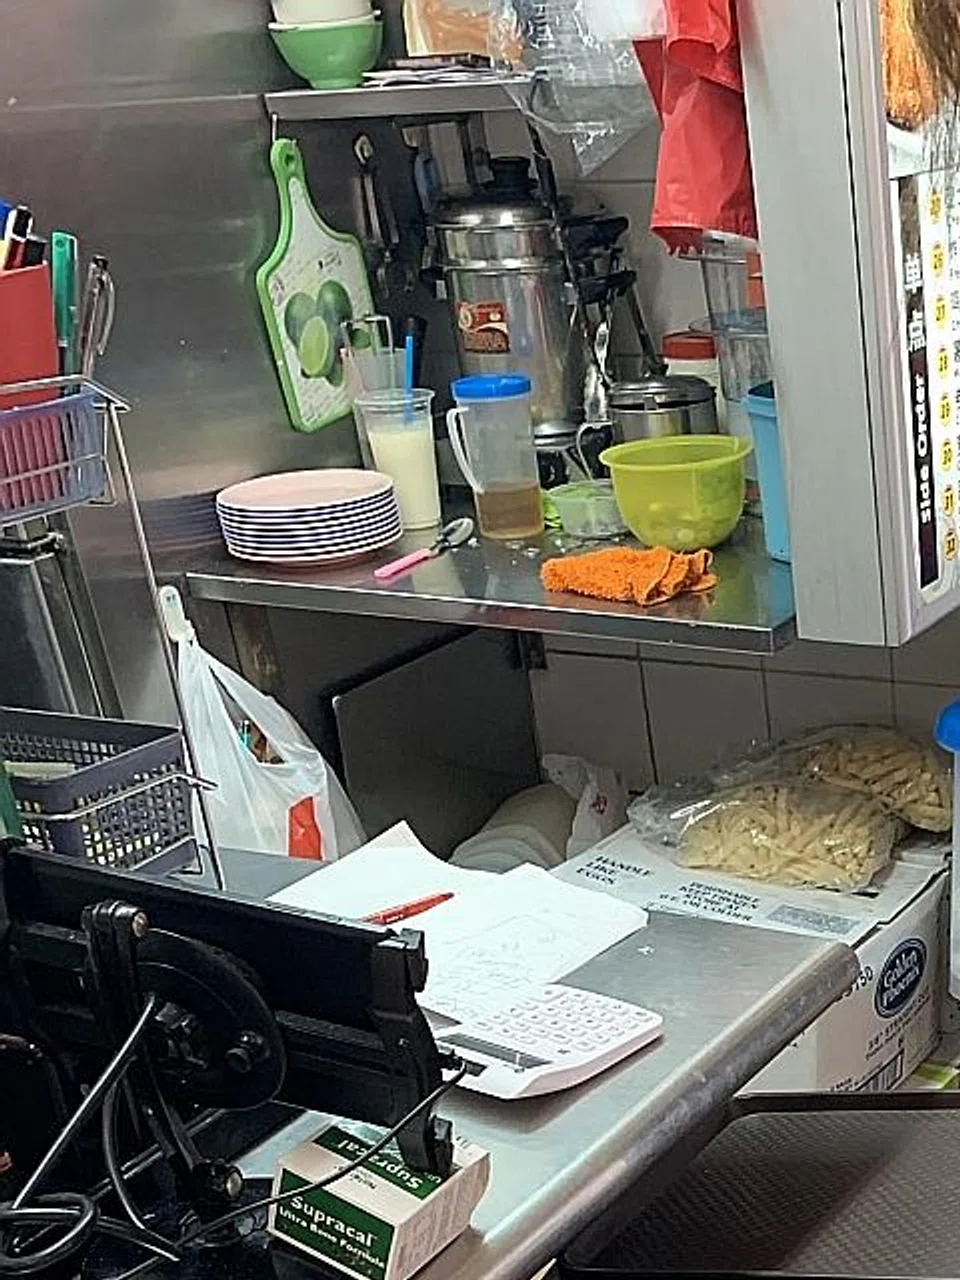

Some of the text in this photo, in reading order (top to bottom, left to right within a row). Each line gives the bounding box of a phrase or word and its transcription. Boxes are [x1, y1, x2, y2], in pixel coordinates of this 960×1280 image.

[914, 374, 928, 458] Order
[919, 464, 932, 524] Side
[576, 867, 615, 885] EGGS
[586, 861, 619, 876] LIKE
[596, 856, 653, 876] HANDLE
[884, 950, 919, 988] Golden
[279, 1204, 307, 1228] Ultra
[340, 1236, 385, 1268] Formula
[290, 1195, 376, 1248] Supracal
